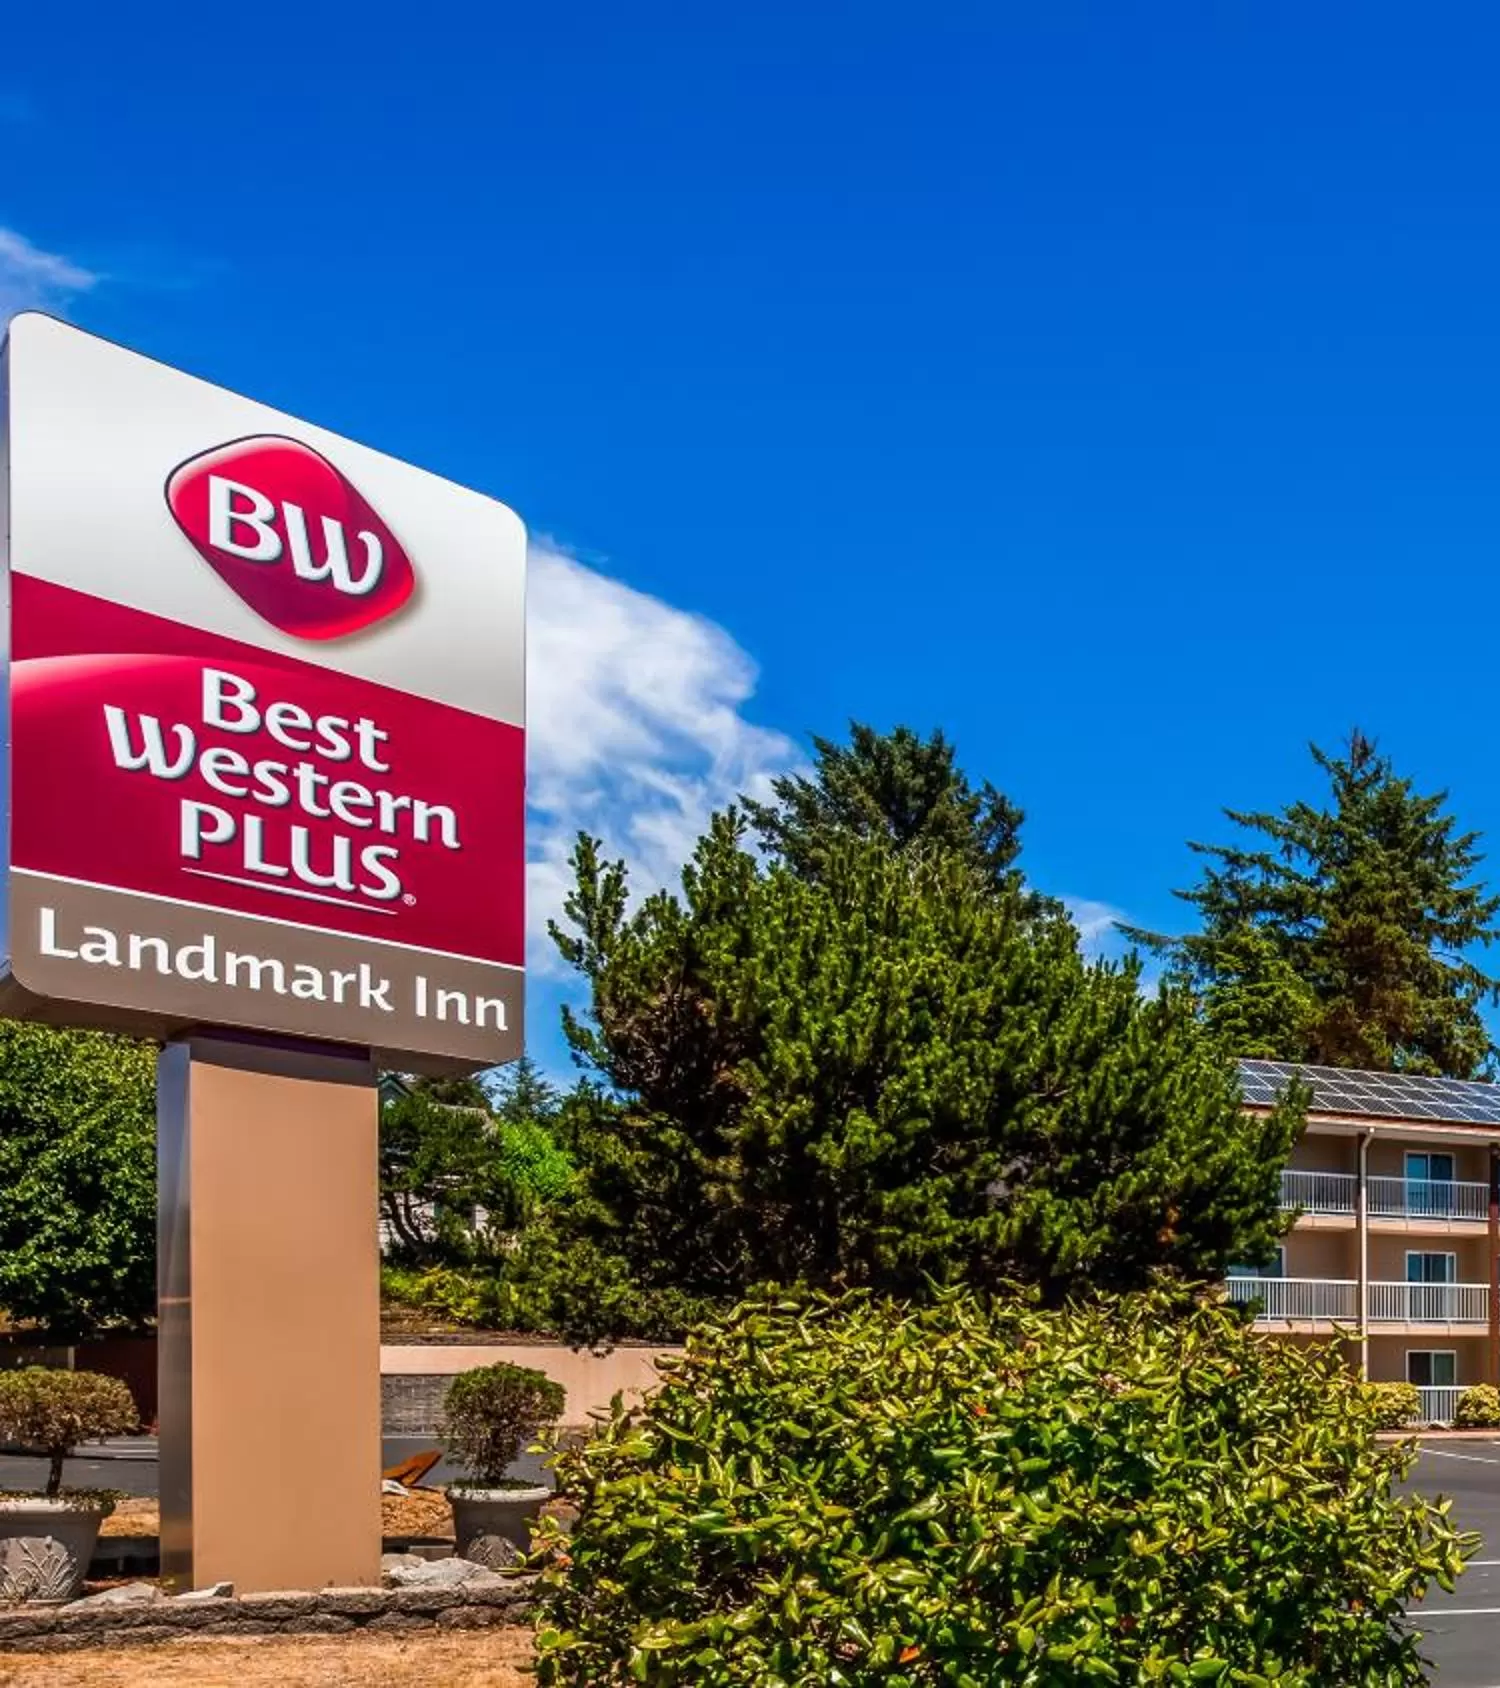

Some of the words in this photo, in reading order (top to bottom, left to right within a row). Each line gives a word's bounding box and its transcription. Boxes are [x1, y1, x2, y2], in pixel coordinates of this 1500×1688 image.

[208, 474, 383, 595] BW
[104, 704, 461, 849] Western
[203, 667, 389, 772] Best
[39, 907, 396, 1012] Landmark
[415, 975, 509, 1031] Inn
